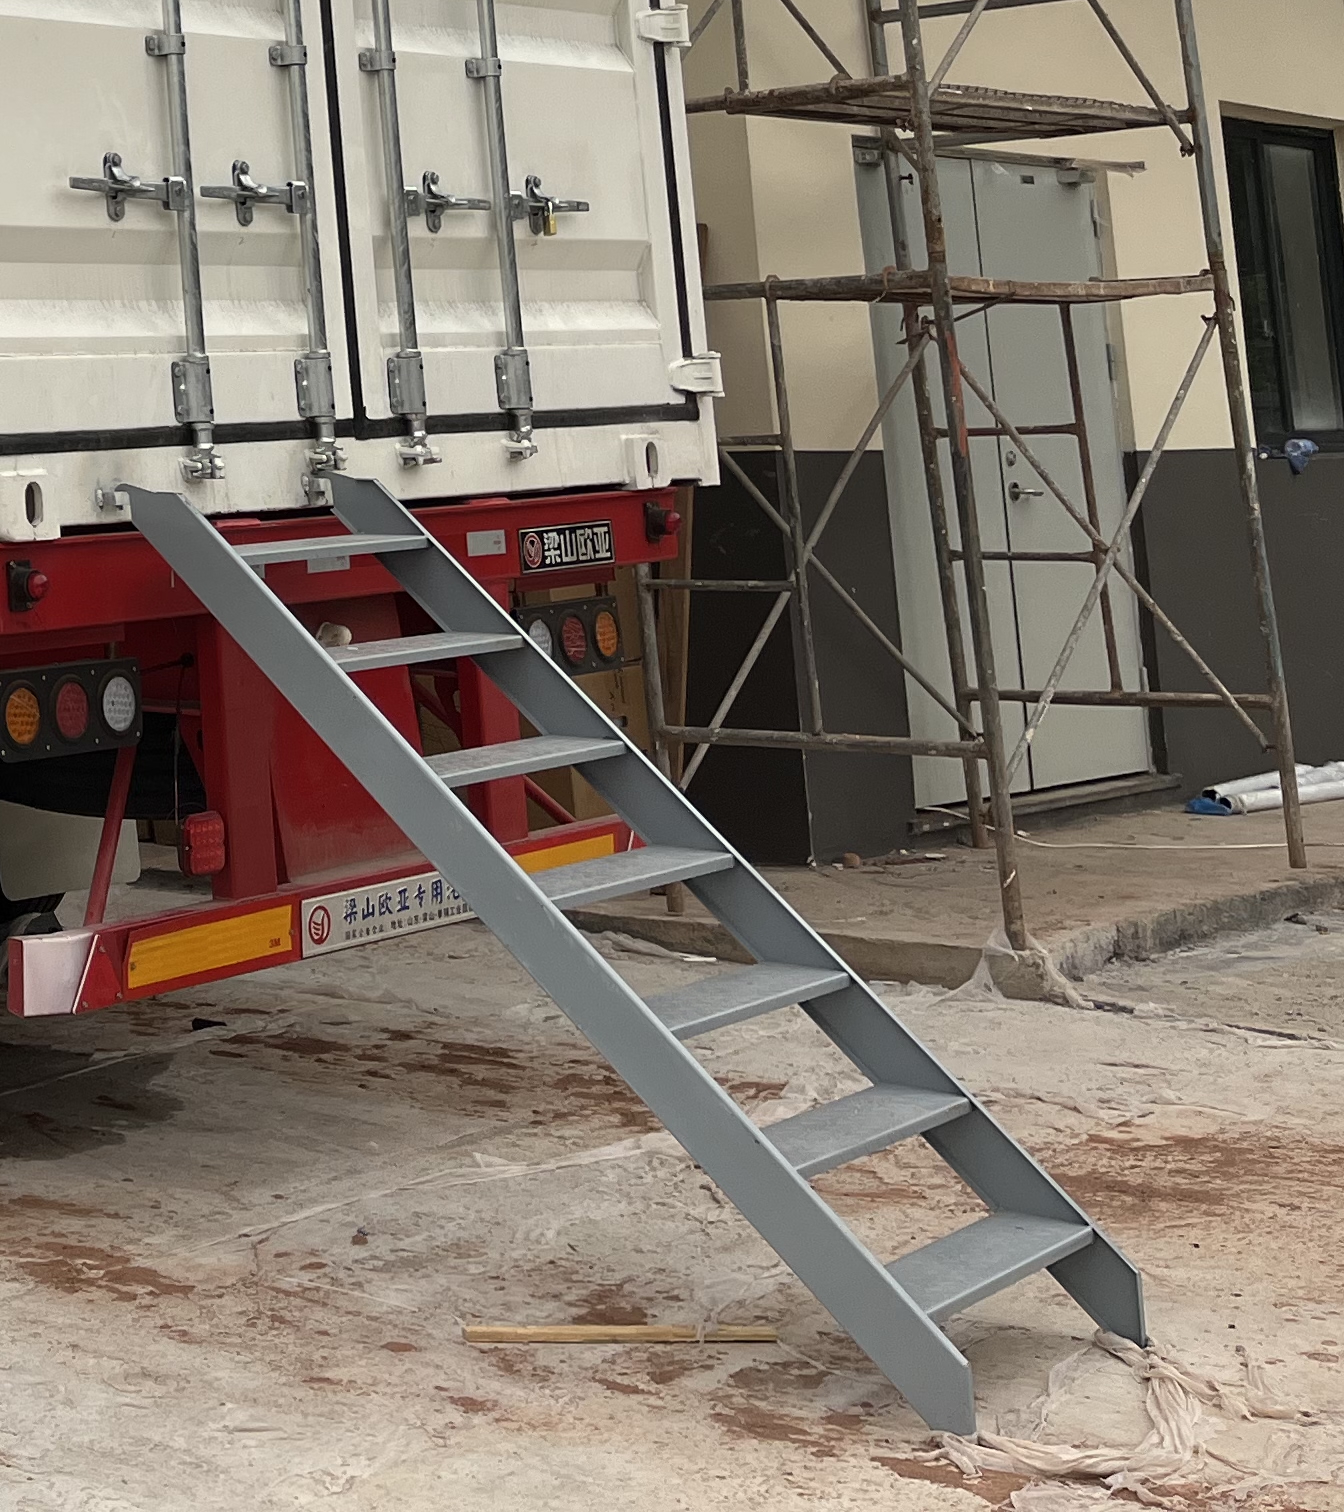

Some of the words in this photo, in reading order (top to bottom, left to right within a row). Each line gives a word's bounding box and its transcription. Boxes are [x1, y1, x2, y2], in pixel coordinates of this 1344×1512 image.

[543, 526, 611, 564] 梁山欧亚
[269, 937, 281, 948] 3M
